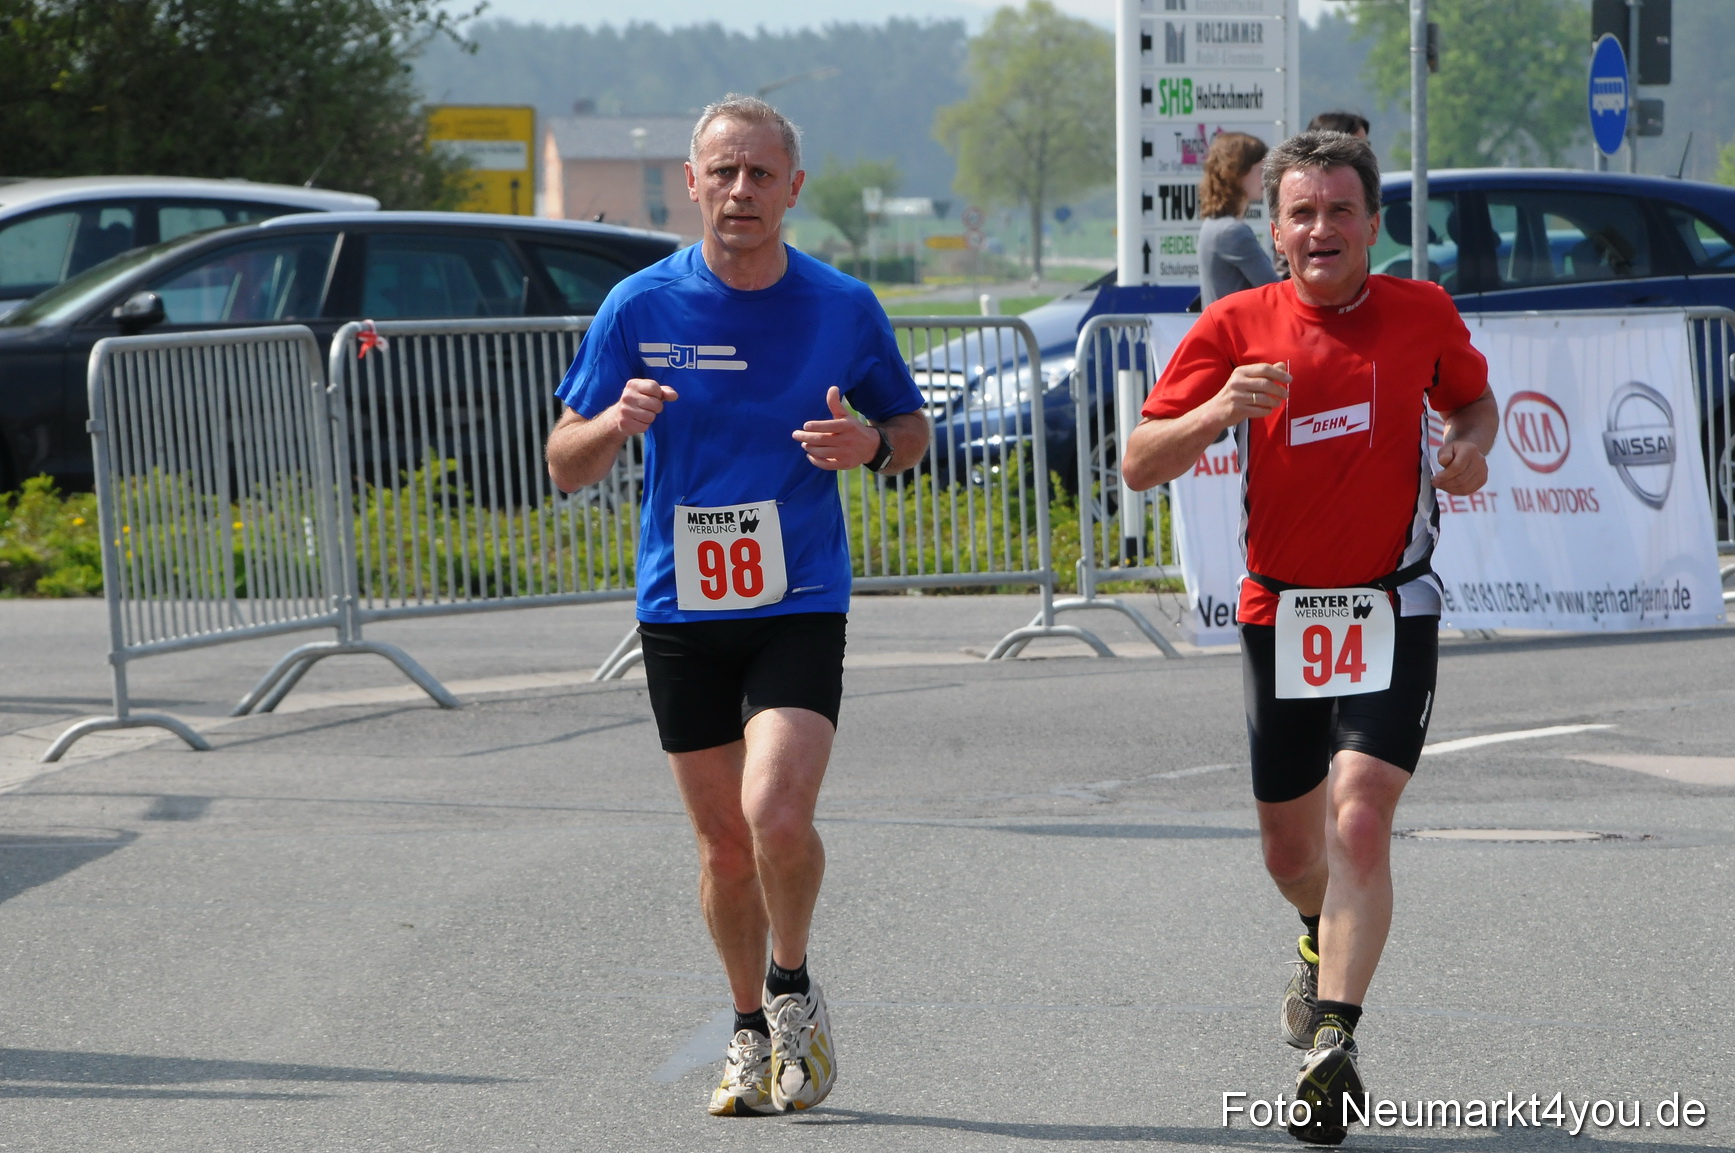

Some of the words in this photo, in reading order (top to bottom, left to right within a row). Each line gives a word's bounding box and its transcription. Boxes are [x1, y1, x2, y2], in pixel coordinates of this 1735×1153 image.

[1196, 22, 1263, 44] HOLZAMMER
[1159, 78, 1193, 116] SHB
[1196, 84, 1263, 110] Holzfachmarkt
[1158, 184, 1201, 221] THU
[1160, 235, 1200, 255] HEIDEL
[1312, 415, 1349, 435] DEHN
[1512, 411, 1562, 454] KIA
[1536, 487, 1600, 514] MOTORS
[687, 511, 735, 525] MEYER
[687, 524, 737, 534] WERBUNG
[697, 537, 764, 600] 98
[1294, 595, 1349, 608] MEYER
[1294, 608, 1350, 618] WERBUNG
[1302, 624, 1367, 687] 94
